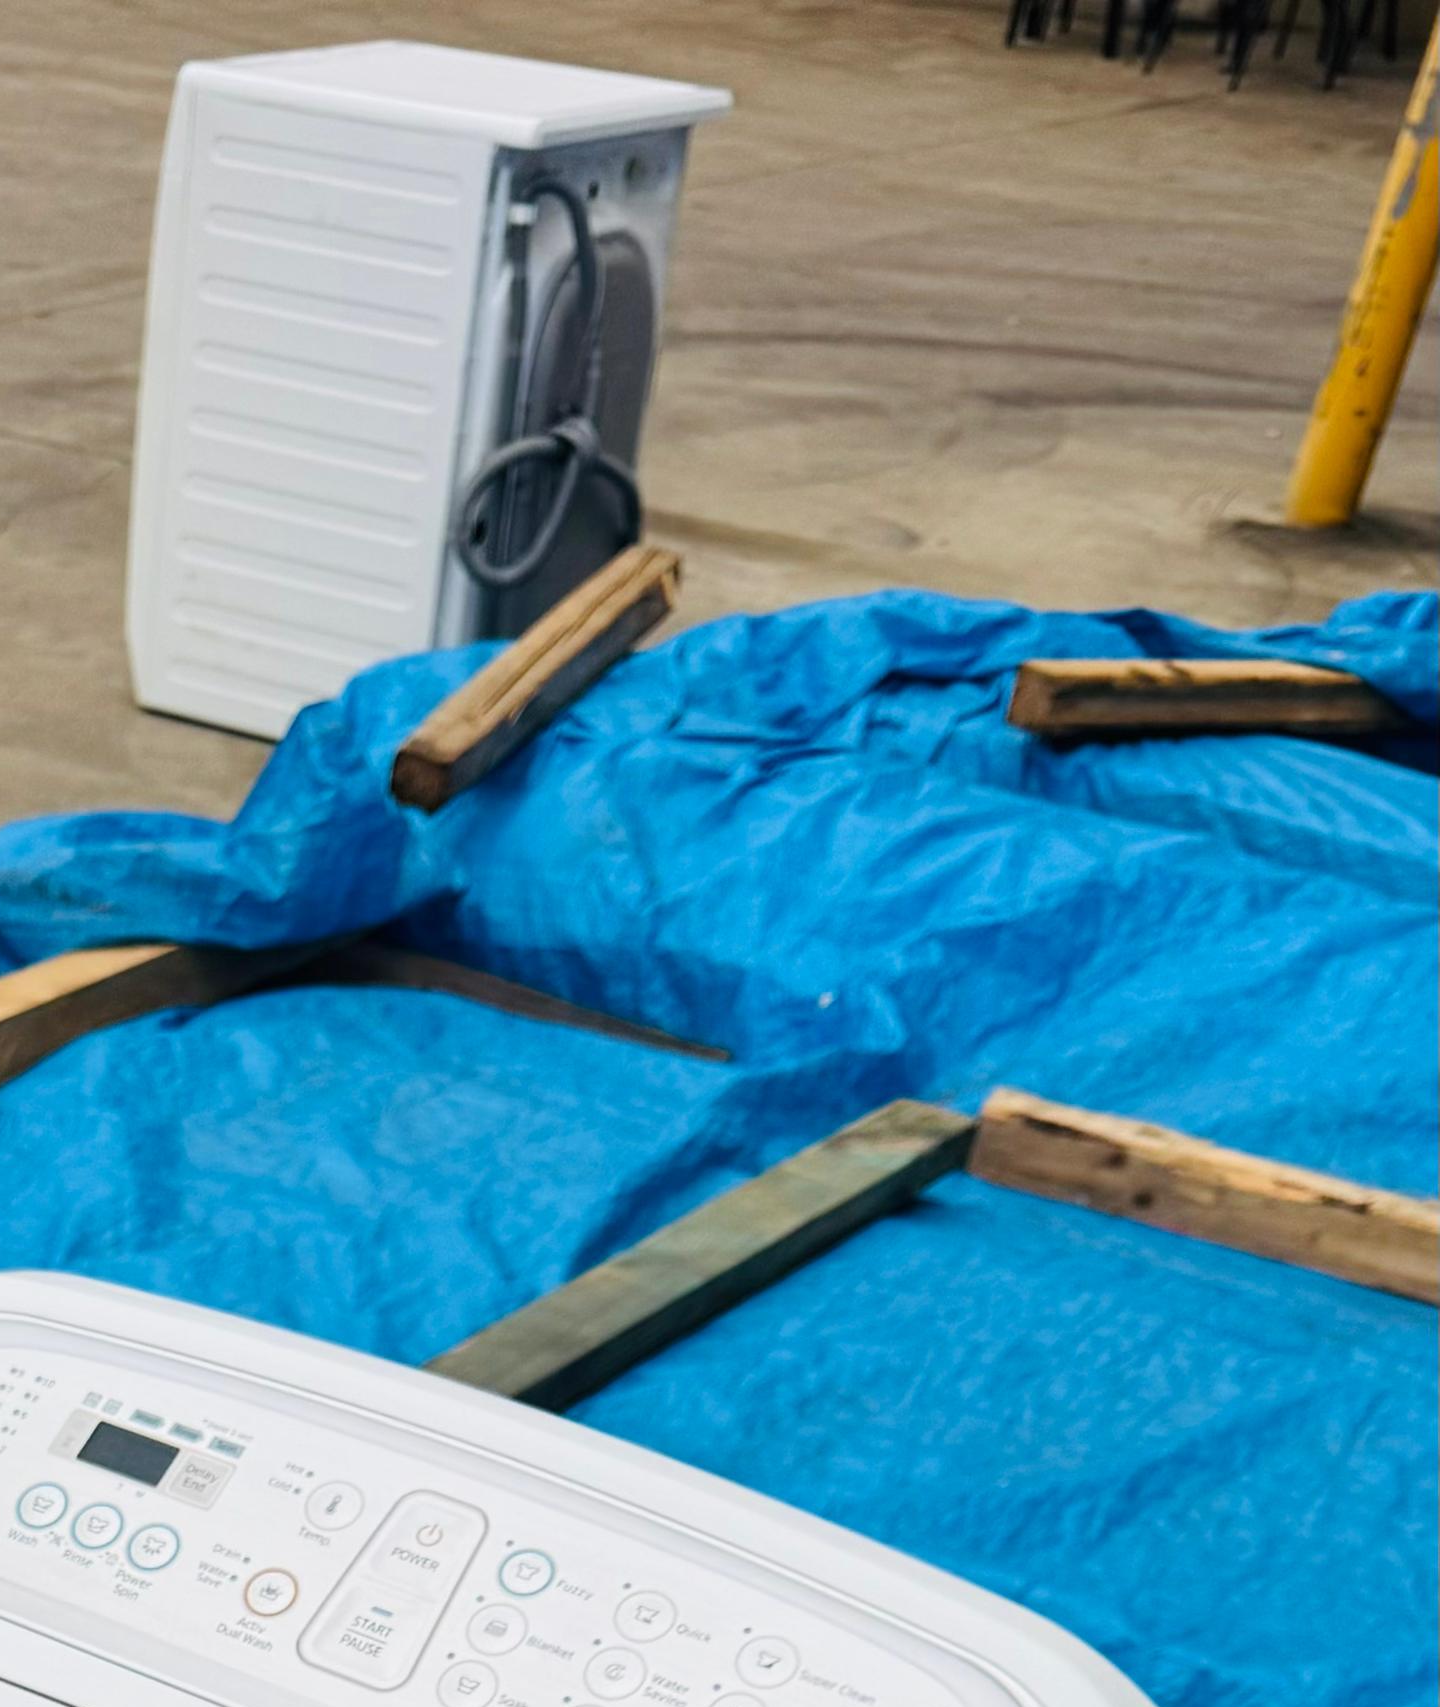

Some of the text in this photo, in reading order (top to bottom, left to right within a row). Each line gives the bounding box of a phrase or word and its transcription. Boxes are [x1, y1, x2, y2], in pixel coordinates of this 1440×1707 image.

[183, 1476, 207, 1493] End
[185, 1463, 219, 1485] Delay
[268, 1477, 294, 1493] Cold
[7, 1528, 39, 1548] Wash
[63, 1548, 94, 1569] Rinse
[212, 1544, 242, 1560] Drain
[391, 1546, 441, 1573] POWER
[115, 1569, 153, 1591] Power
[198, 1561, 230, 1579] Water
[113, 1583, 140, 1602] Spin
[557, 1578, 596, 1601] Fuzzy
[352, 1614, 393, 1637] START
[677, 1623, 712, 1644] Quick
[216, 1623, 273, 1651] Dual Wash
[339, 1634, 384, 1659] PAUSE
[526, 1635, 575, 1661] Blanket
[651, 1674, 690, 1696] Water
[799, 1669, 876, 1705] Super Clean
